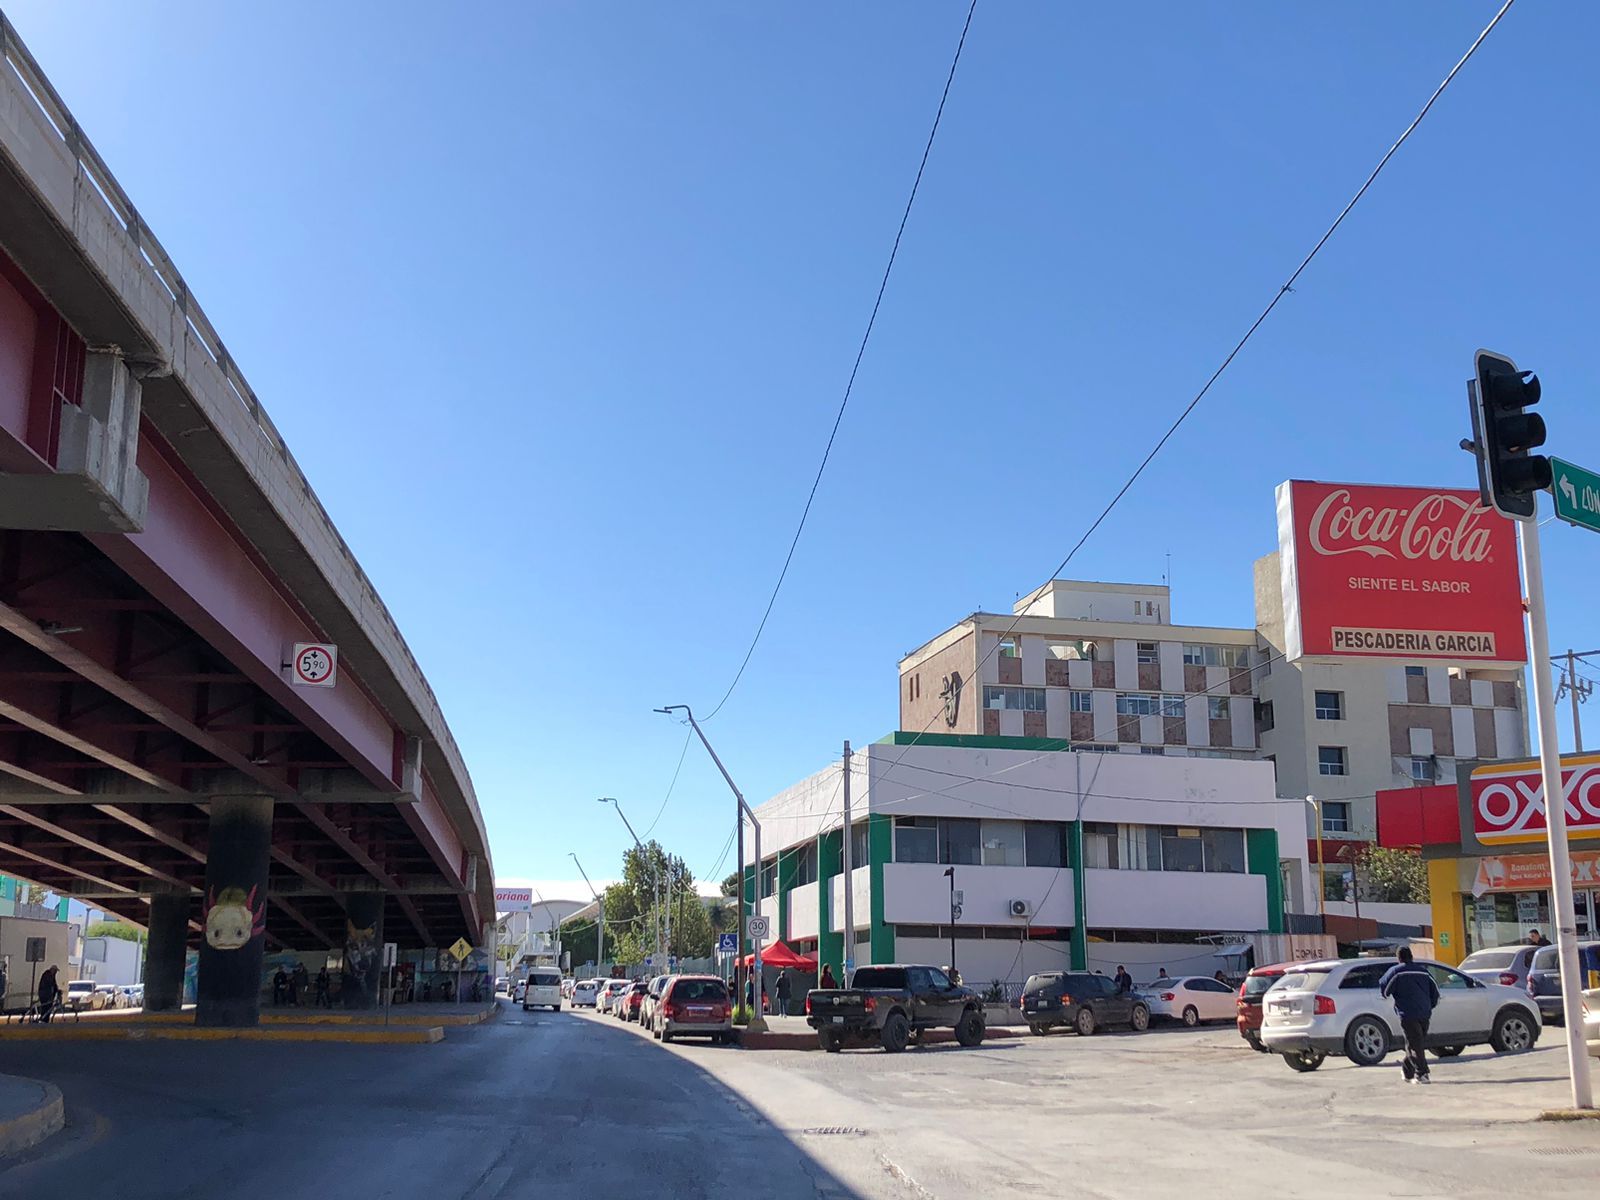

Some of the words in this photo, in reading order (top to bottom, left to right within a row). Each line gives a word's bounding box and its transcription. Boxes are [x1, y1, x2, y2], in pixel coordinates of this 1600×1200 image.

[1309, 490, 1493, 562] Coca-Cola
[1348, 576, 1398, 591] SIENTE
[1401, 579, 1419, 592] EL
[1422, 580, 1471, 594] SABOR
[1334, 630, 1432, 651] PESCADERIA
[1435, 634, 1493, 653] GARCIA
[1478, 768, 1600, 832] OXXO
[496, 891, 530, 901] oriana
[752, 922, 764, 930] 30
